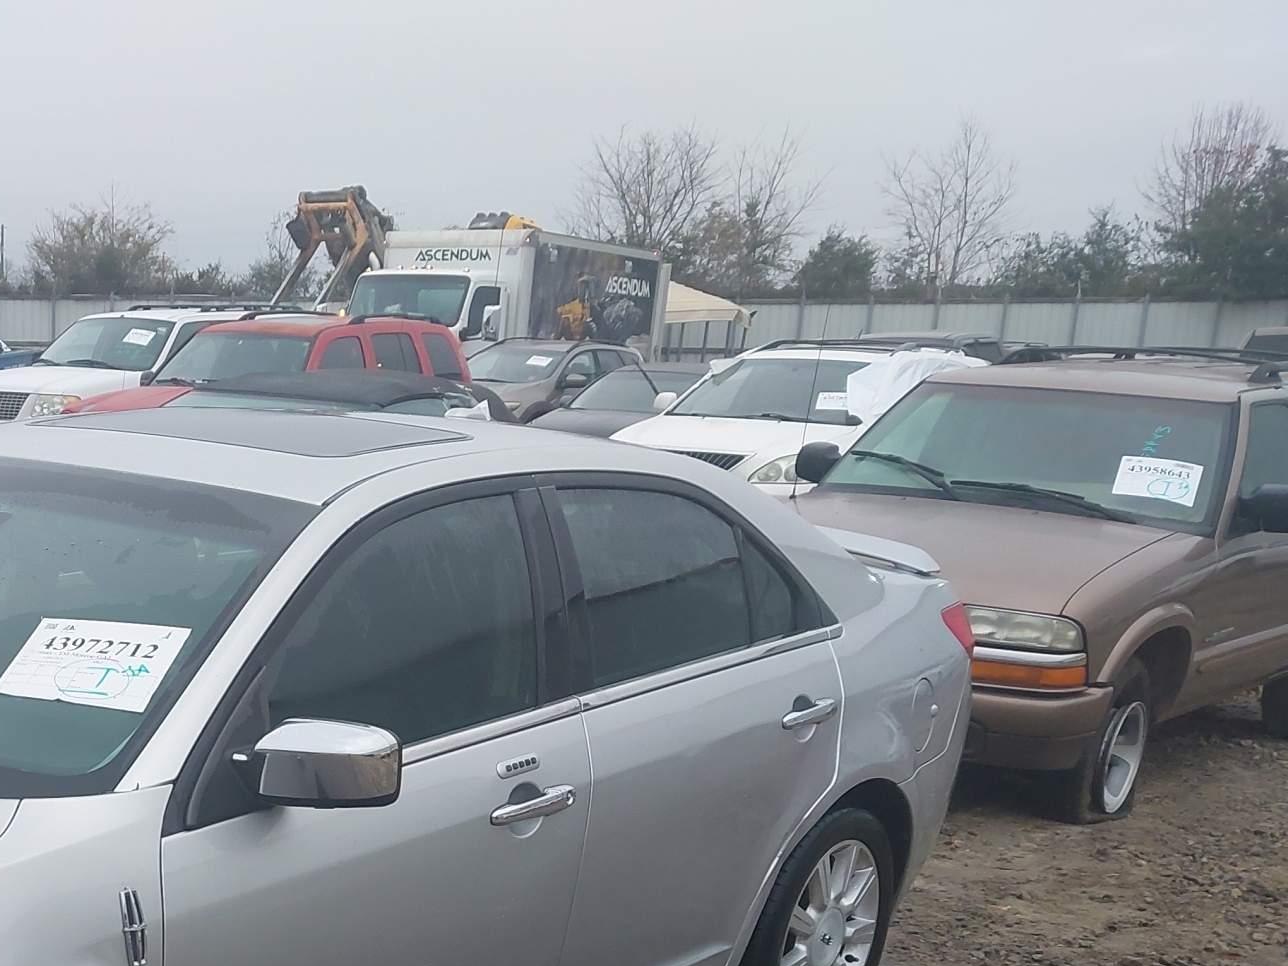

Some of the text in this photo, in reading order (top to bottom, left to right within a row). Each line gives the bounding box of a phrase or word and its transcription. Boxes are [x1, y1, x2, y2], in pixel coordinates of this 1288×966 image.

[415, 248, 492, 262] ASCENDUM
[605, 276, 651, 298] ASCENDUM
[1127, 464, 1192, 480] 43958643
[42, 635, 160, 659] 43972712
